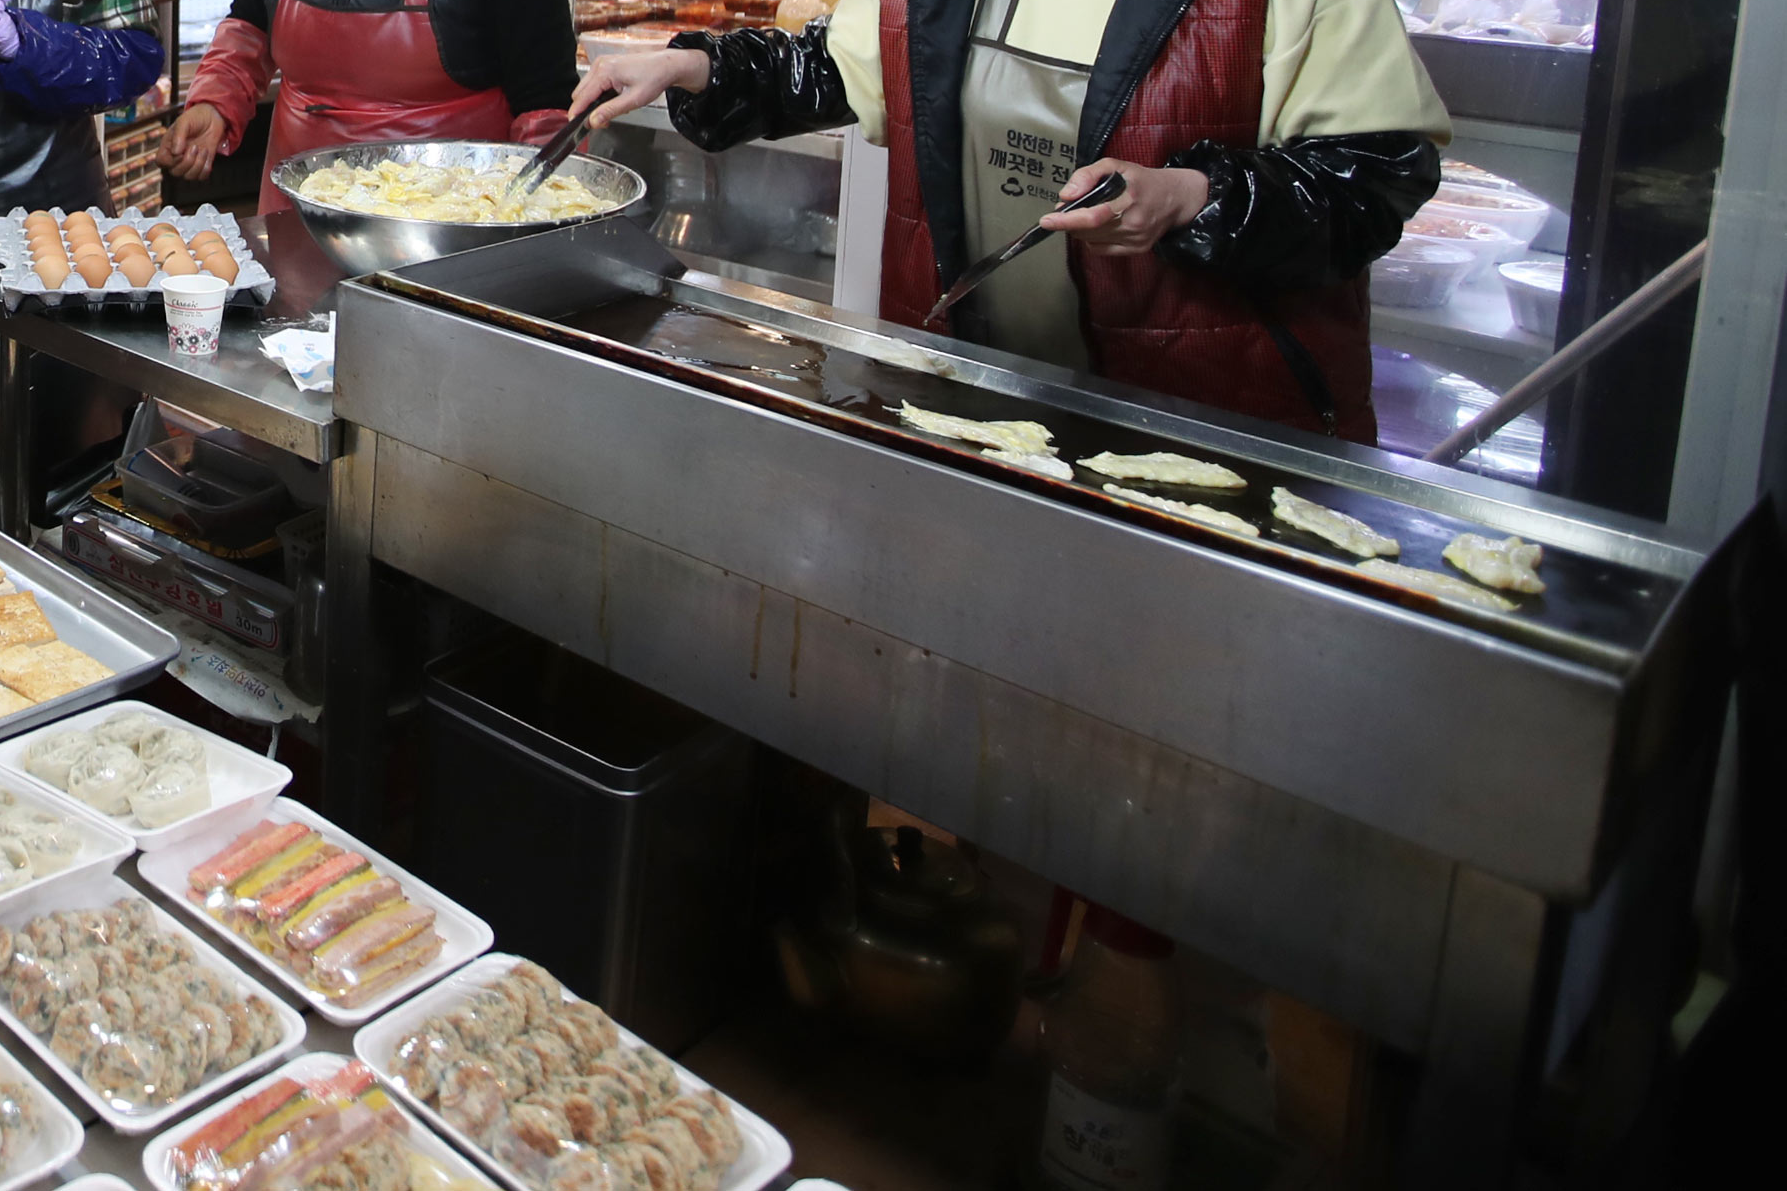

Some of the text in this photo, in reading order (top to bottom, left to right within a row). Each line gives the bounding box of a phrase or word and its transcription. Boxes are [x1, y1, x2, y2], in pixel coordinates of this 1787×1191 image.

[1006, 129, 1054, 157] 안전한
[988, 147, 1045, 178] 깨끗한
[234, 614, 264, 638] 30m
